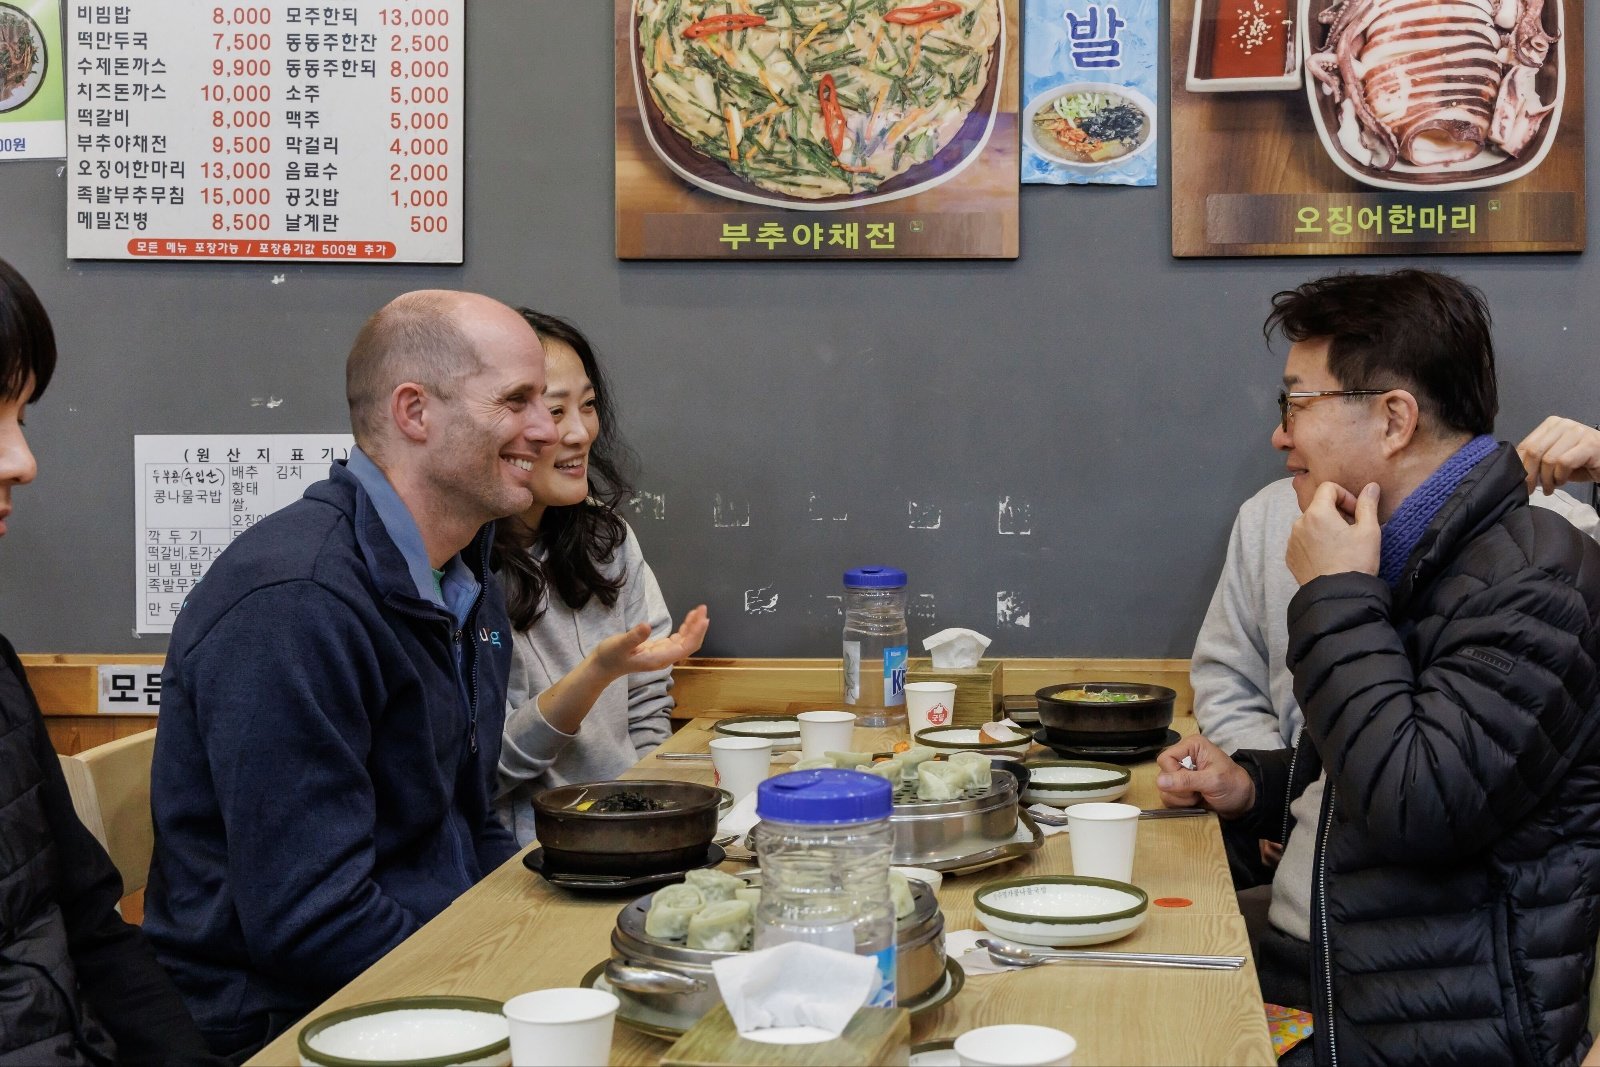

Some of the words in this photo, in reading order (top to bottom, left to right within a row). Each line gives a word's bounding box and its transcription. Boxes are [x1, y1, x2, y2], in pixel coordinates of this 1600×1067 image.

[78, 6, 131, 24] 비빔밥
[213, 8, 270, 25] 8,000
[287, 7, 357, 26] 모주한되
[379, 9, 448, 27] 13,000
[78, 32, 147, 50] 떡만두국
[213, 33, 270, 51] 7,500
[287, 33, 377, 52] 동동주한잔
[391, 35, 448, 53] 2,500
[1066, 7, 1124, 67] 발
[78, 58, 166, 75] 수제돈까스
[213, 59, 270, 77] 9,900
[286, 59, 375, 78] 동동주한되
[391, 61, 448, 79] 8,000
[78, 83, 166, 101] 치즈돈까스
[201, 85, 270, 103] 10,000
[286, 85, 319, 103] 소주
[391, 87, 448, 104] 5,000
[78, 109, 128, 127] 떡갈비
[213, 111, 270, 128] 8,000
[286, 111, 319, 128] 맥주
[391, 113, 448, 131] 5,000
[78, 134, 166, 153] 부추야채전
[213, 137, 270, 154] 9,500
[287, 137, 337, 155] 막걸리
[390, 138, 448, 156] 4,000
[78, 160, 184, 179] 오징어한마리
[201, 162, 270, 180] 13,000
[286, 162, 337, 180] 음료수
[390, 164, 447, 182] 2,000
[78, 186, 183, 204] 족발부추무침
[201, 188, 270, 206] 15,000
[286, 188, 339, 206] 공깃밥
[391, 190, 447, 208] 1,000
[78, 212, 147, 230] 메밀전병
[213, 214, 269, 231] 8,500
[286, 214, 339, 232] 날계란
[411, 216, 447, 232] 500
[1294, 204, 1477, 235] 오징어한마리
[719, 222, 896, 250] 부추야채전
[137, 241, 158, 253] 모든
[166, 242, 187, 254] 메뉴
[194, 242, 239, 255] 포장가능
[259, 243, 315, 256] 포장용기값
[322, 244, 357, 256] 500원
[364, 244, 387, 256] 추가
[231, 465, 258, 480] 배추
[276, 465, 302, 480] 김치
[154, 489, 222, 504] 콩나물국밥
[231, 481, 258, 496] 황태
